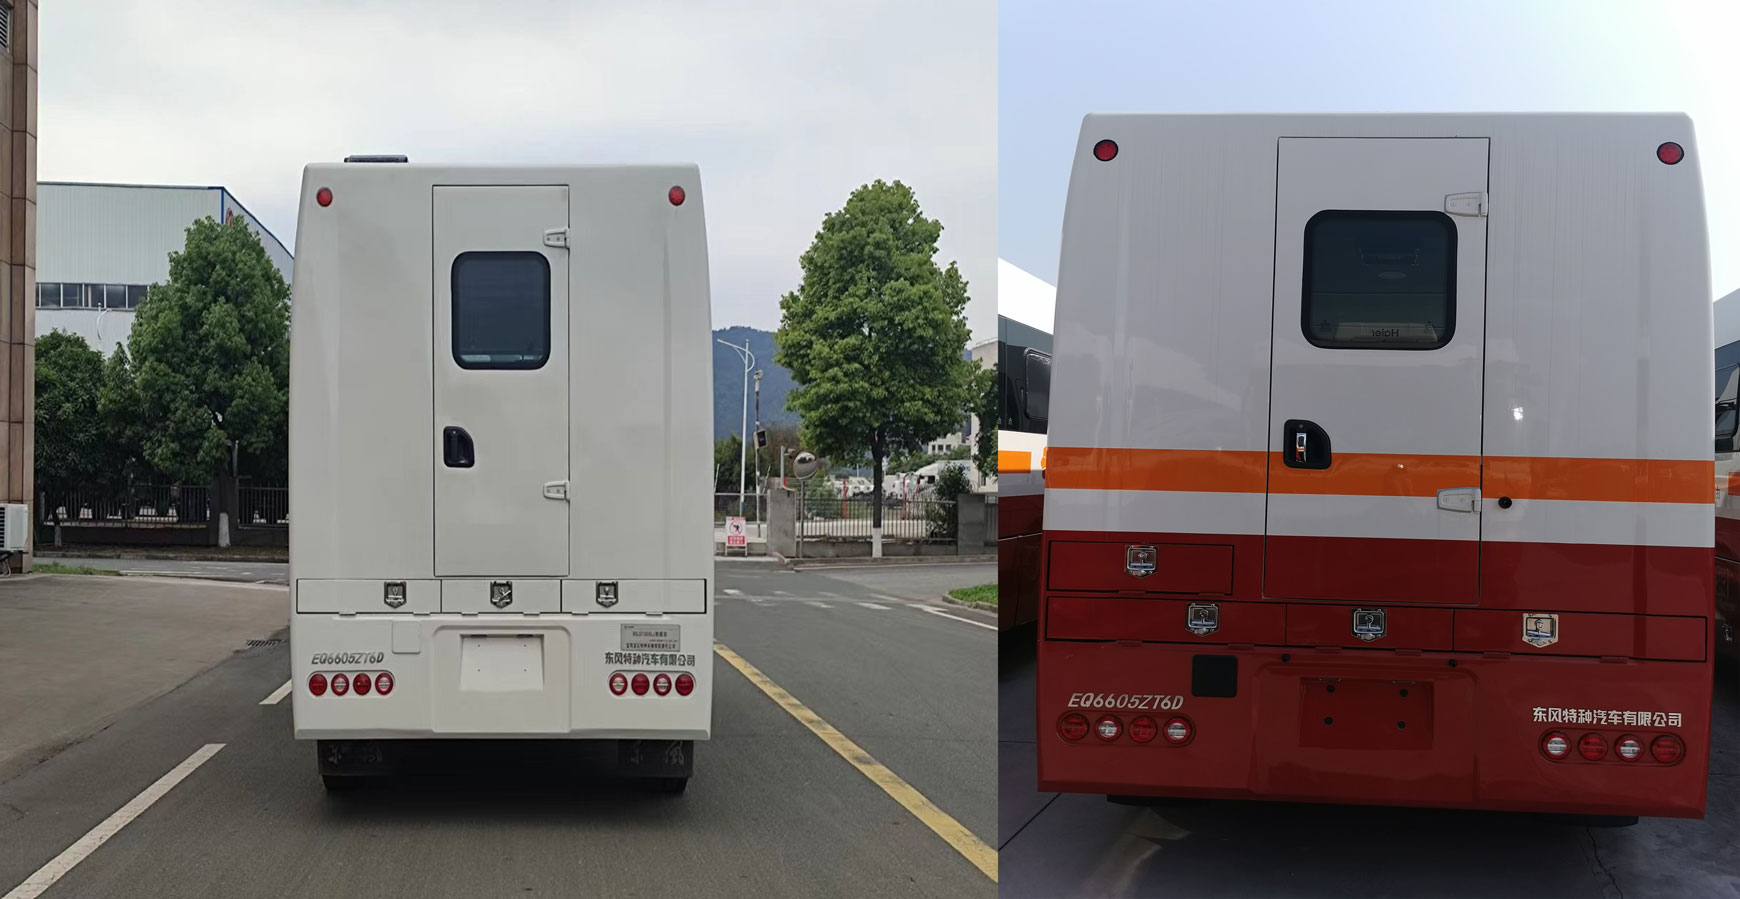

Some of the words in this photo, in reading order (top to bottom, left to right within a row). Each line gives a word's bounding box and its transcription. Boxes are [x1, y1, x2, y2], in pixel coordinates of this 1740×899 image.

[310, 652, 385, 665] EQ6605ZT6D
[604, 651, 696, 667] 东风特种汽车有限公司
[1067, 692, 1184, 710] EQ6605ZT6D
[1532, 706, 1683, 728] 东风特种汽车有限公司
